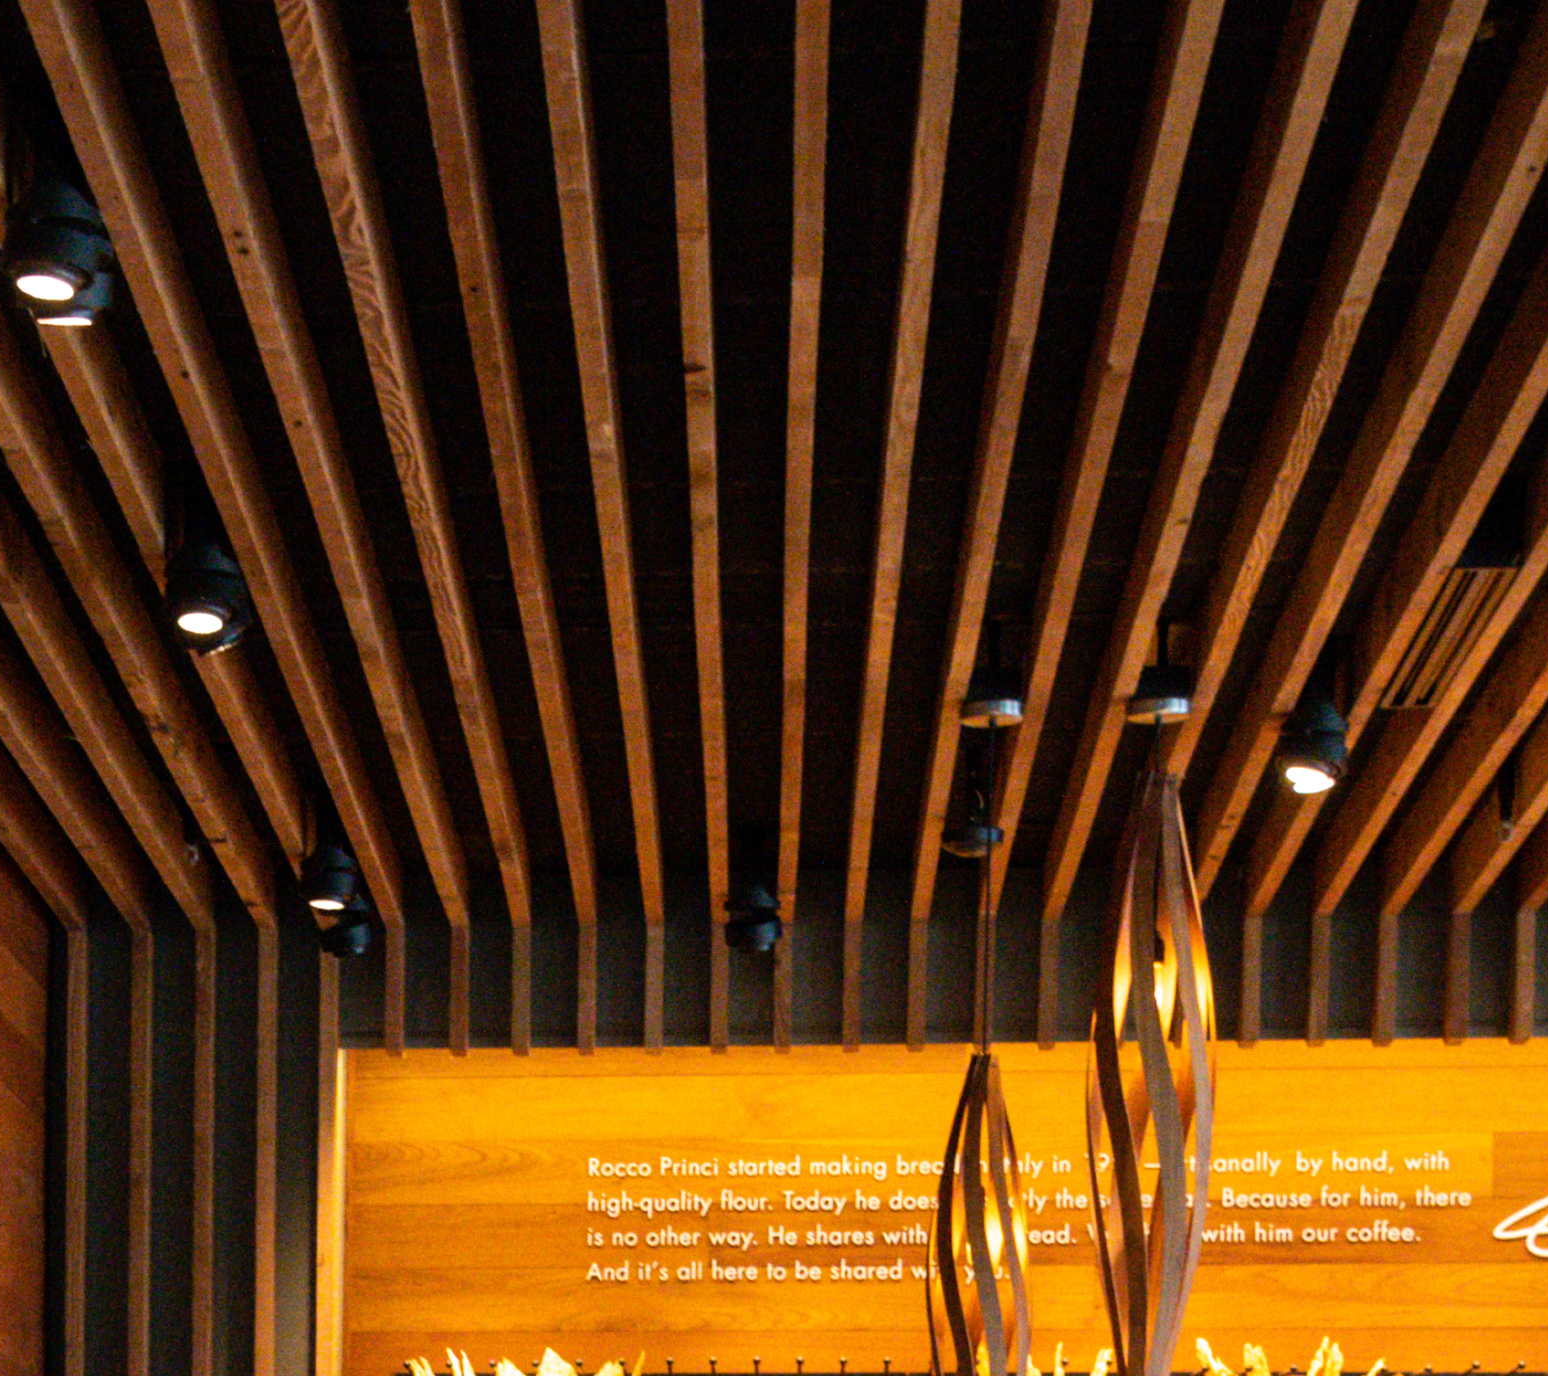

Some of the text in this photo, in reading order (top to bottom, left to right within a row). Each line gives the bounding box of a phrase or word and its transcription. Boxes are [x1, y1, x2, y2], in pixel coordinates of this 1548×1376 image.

[587, 1158, 652, 1177] Rocco
[661, 1156, 719, 1177] Princi
[728, 1154, 801, 1176] started
[809, 1154, 888, 1181] making
[1052, 1155, 1072, 1174] in
[1295, 1150, 1323, 1177] by
[1332, 1149, 1395, 1174] hand,
[1404, 1150, 1450, 1172] with
[587, 1190, 712, 1219] high-quality
[721, 1189, 774, 1211] flour.
[782, 1190, 847, 1216] Today
[855, 1189, 881, 1211] he
[1055, 1187, 1089, 1209] the
[1221, 1187, 1313, 1208] Because
[1320, 1185, 1351, 1207] for
[1359, 1185, 1406, 1211] him,
[1415, 1185, 1472, 1207] there
[586, 1227, 604, 1247] is
[611, 1230, 639, 1247] no
[646, 1225, 701, 1247] other
[707, 1231, 758, 1251] way.
[768, 1225, 799, 1246] He
[805, 1224, 875, 1246] shares
[882, 1223, 928, 1245] with
[1200, 1221, 1246, 1243] with
[1254, 1220, 1294, 1243] him
[1301, 1227, 1338, 1243] our
[1346, 1219, 1422, 1243] coffee.
[586, 1262, 630, 1282] And
[637, 1261, 669, 1282] it's
[677, 1260, 703, 1282] all
[711, 1259, 759, 1281] here
[767, 1263, 787, 1281] to
[794, 1258, 822, 1281] be
[830, 1258, 903, 1282] shared
